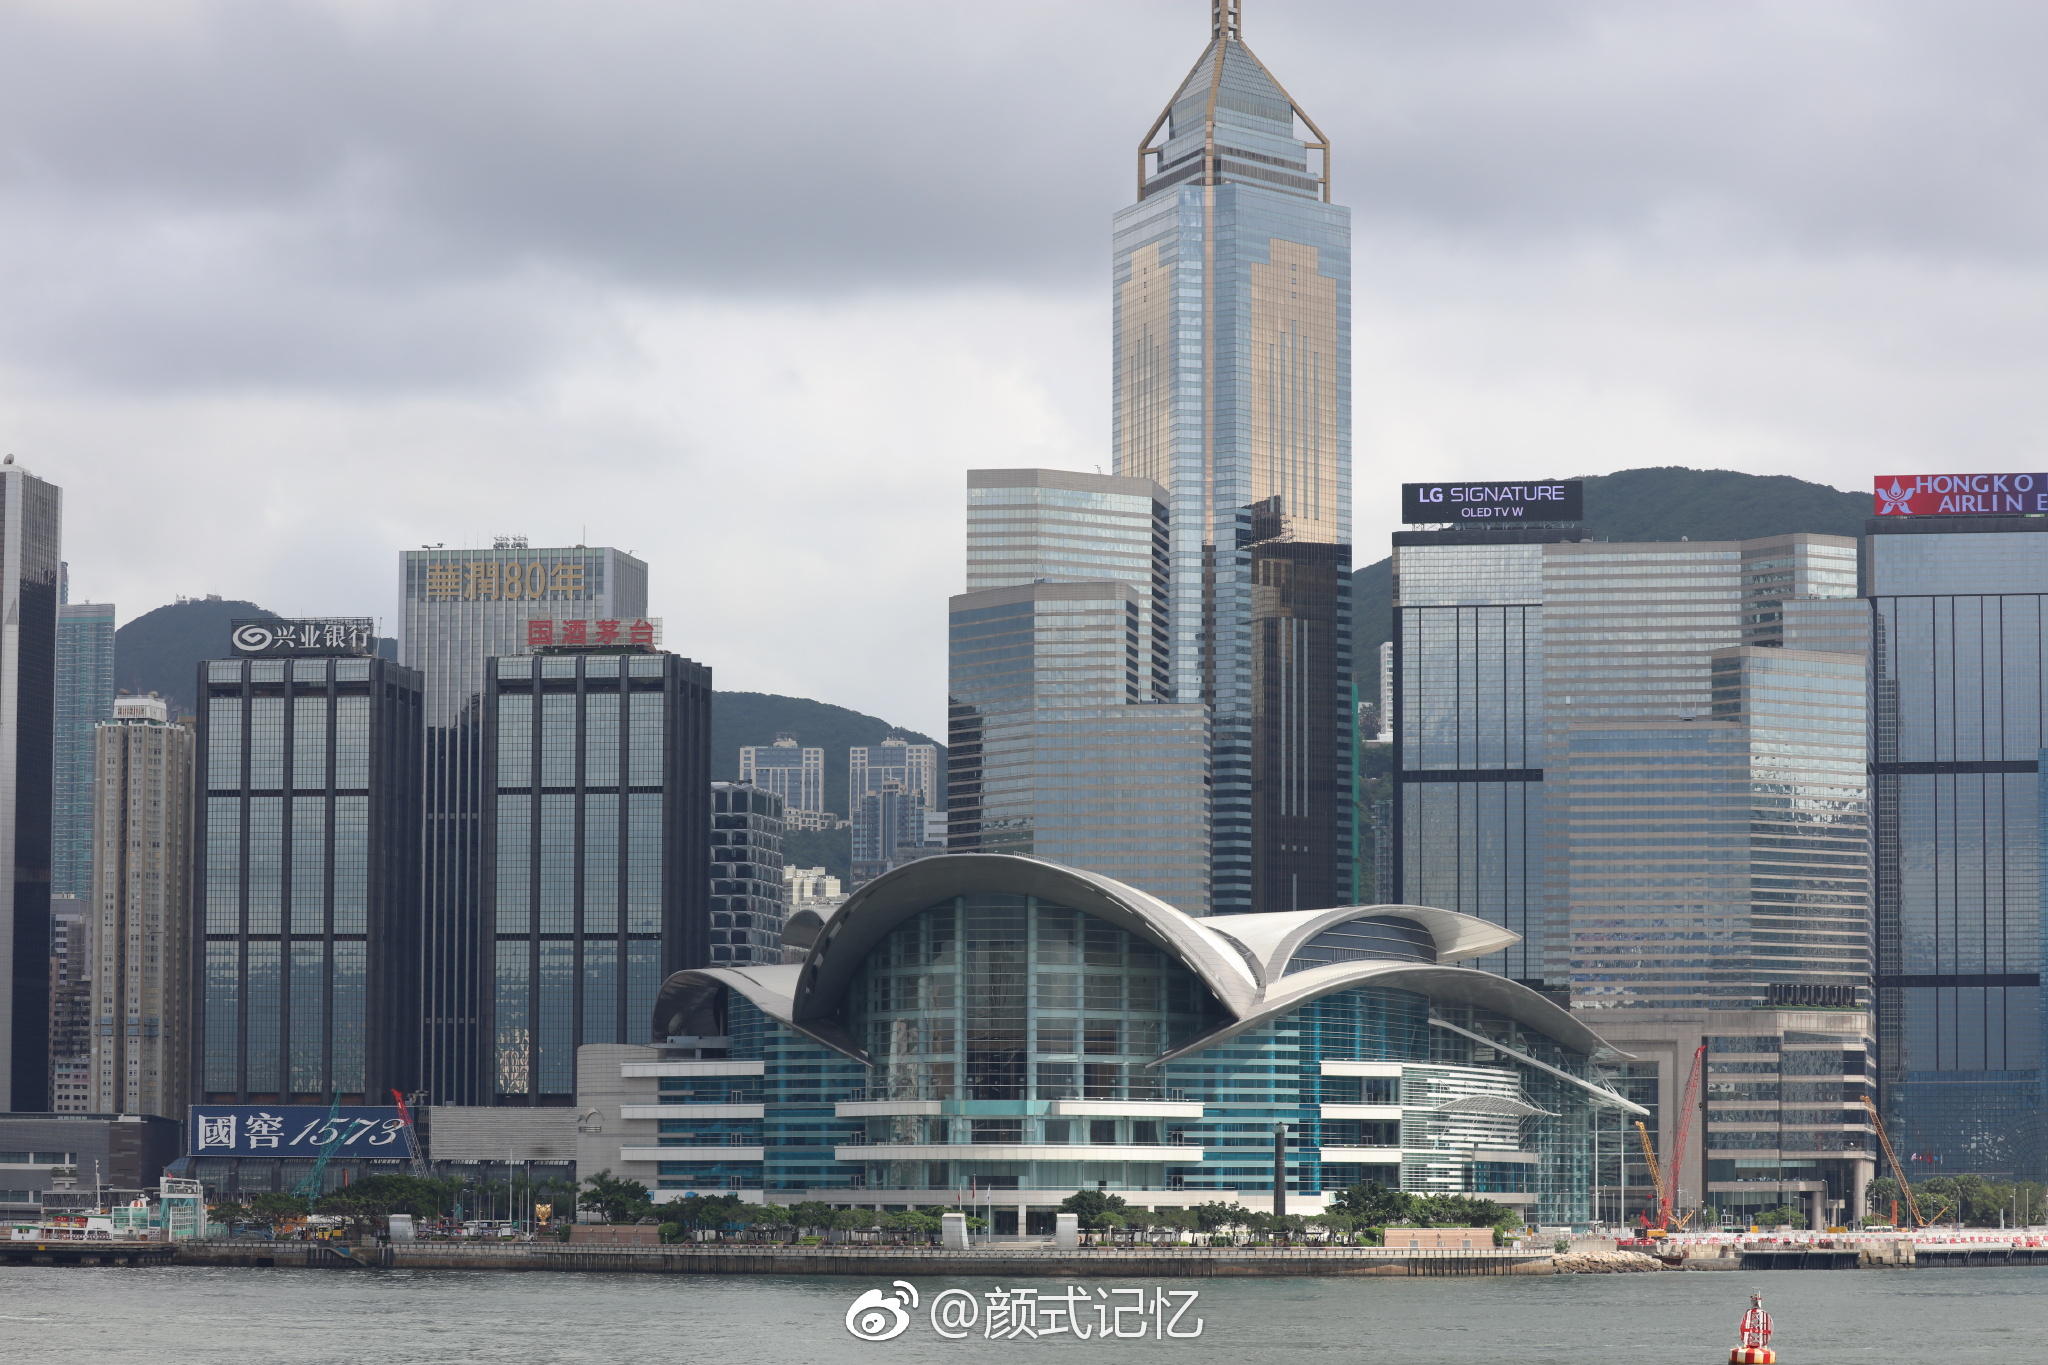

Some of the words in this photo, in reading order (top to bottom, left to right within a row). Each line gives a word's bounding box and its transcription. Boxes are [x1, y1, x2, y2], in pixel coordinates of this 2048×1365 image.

[1419, 488, 1443, 503] LG
[1450, 486, 1565, 502] SIGNATURE
[1916, 475, 2048, 494] HONGKO
[1461, 508, 1492, 518] OLED
[1494, 507, 1509, 517] TV
[1512, 507, 1524, 517] W
[426, 561, 585, 600] 華潤80年
[273, 624, 371, 649] 兴业银行
[528, 619, 654, 646] 国酒茅台
